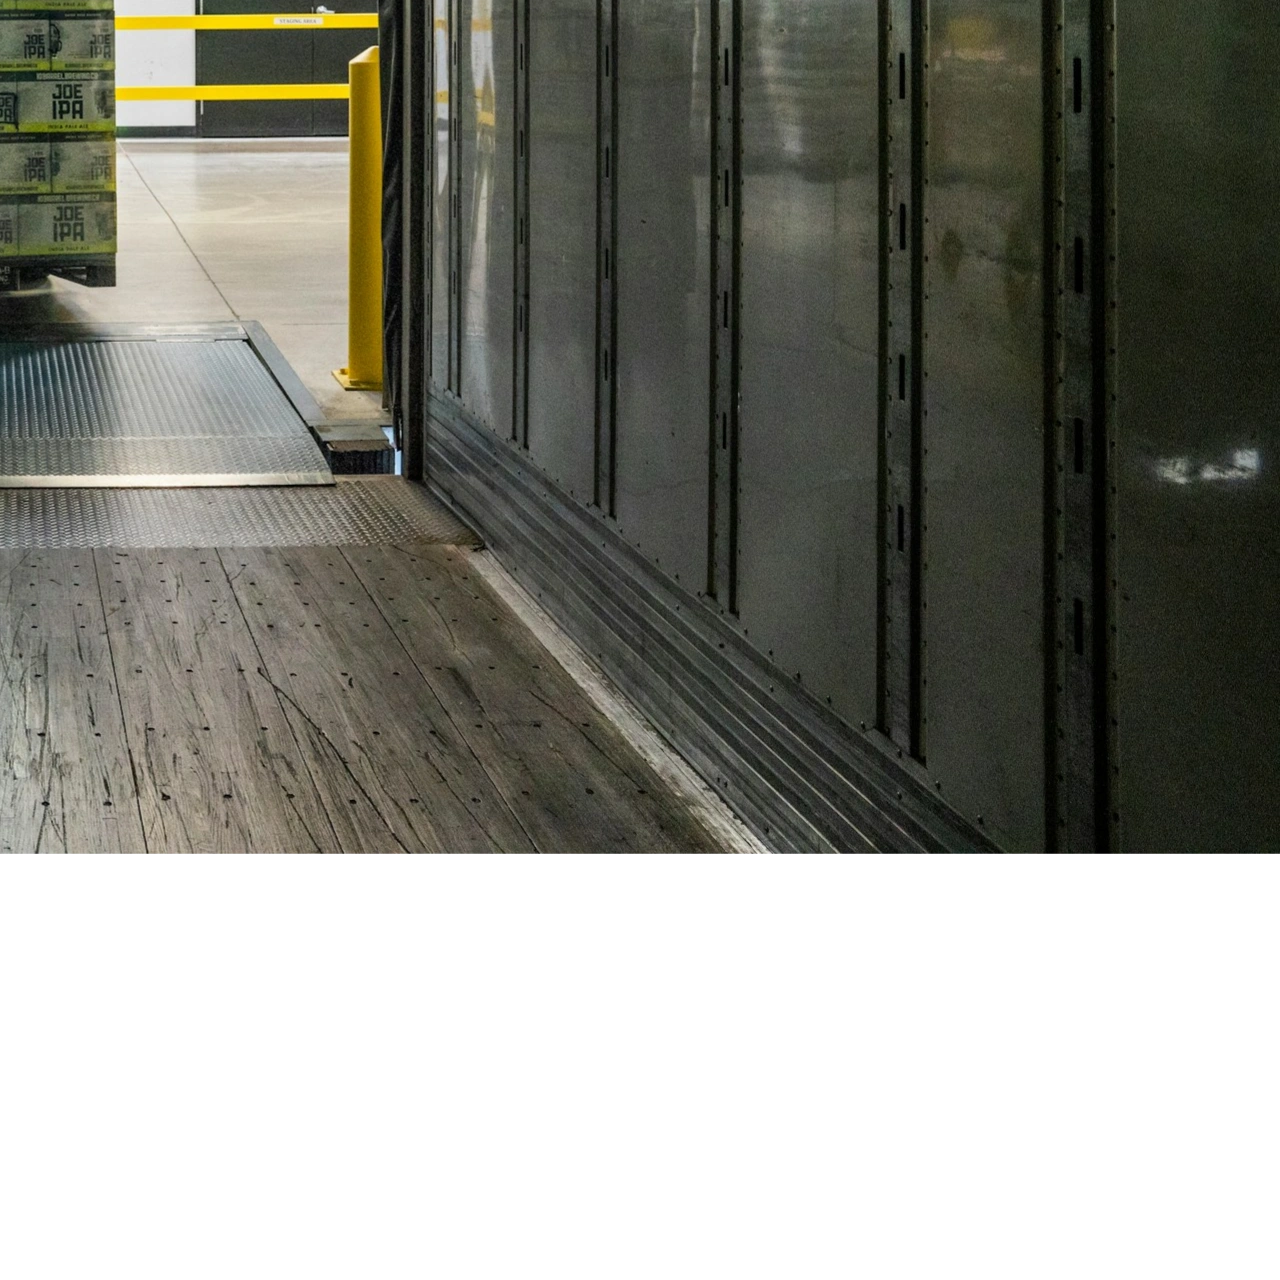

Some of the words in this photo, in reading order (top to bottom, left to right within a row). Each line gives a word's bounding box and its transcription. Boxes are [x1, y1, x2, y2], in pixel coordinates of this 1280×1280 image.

[24, 34, 45, 45] JOE
[89, 34, 111, 45] JOE
[24, 45, 46, 59] IPA
[89, 46, 111, 58] IPA
[52, 84, 83, 99] JOE
[52, 100, 83, 119] IPA
[24, 157, 45, 168] JOE
[24, 168, 46, 182] IPA
[53, 206, 84, 221] JOE
[53, 222, 85, 242] IPA
